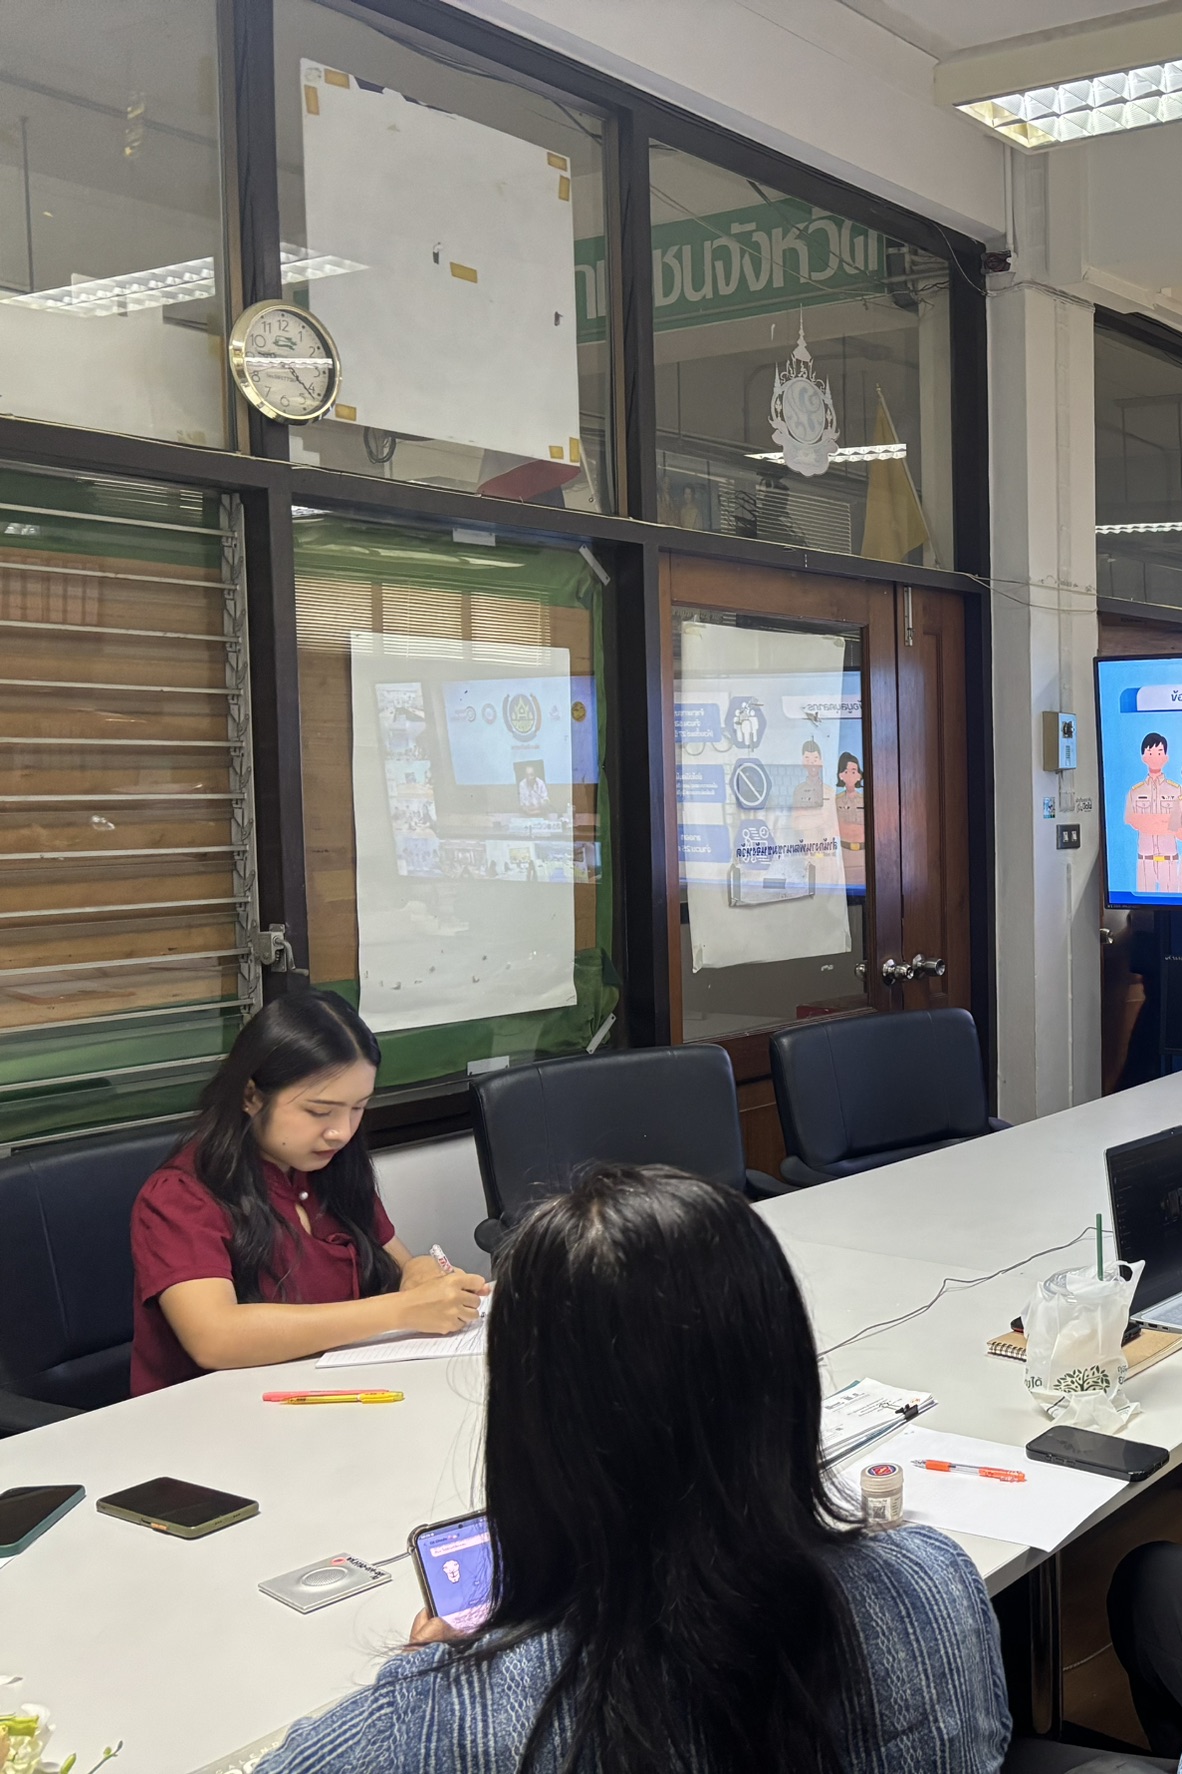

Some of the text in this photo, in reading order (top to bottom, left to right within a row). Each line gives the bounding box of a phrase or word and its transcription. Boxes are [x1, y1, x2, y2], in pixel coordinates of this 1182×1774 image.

[261, 321, 272, 334] 11
[276, 319, 290, 333] 12
[250, 333, 266, 348] 10
[309, 346, 316, 358] 2
[251, 370, 260, 382] 8
[264, 385, 272, 398] 7
[280, 395, 290, 408] 6
